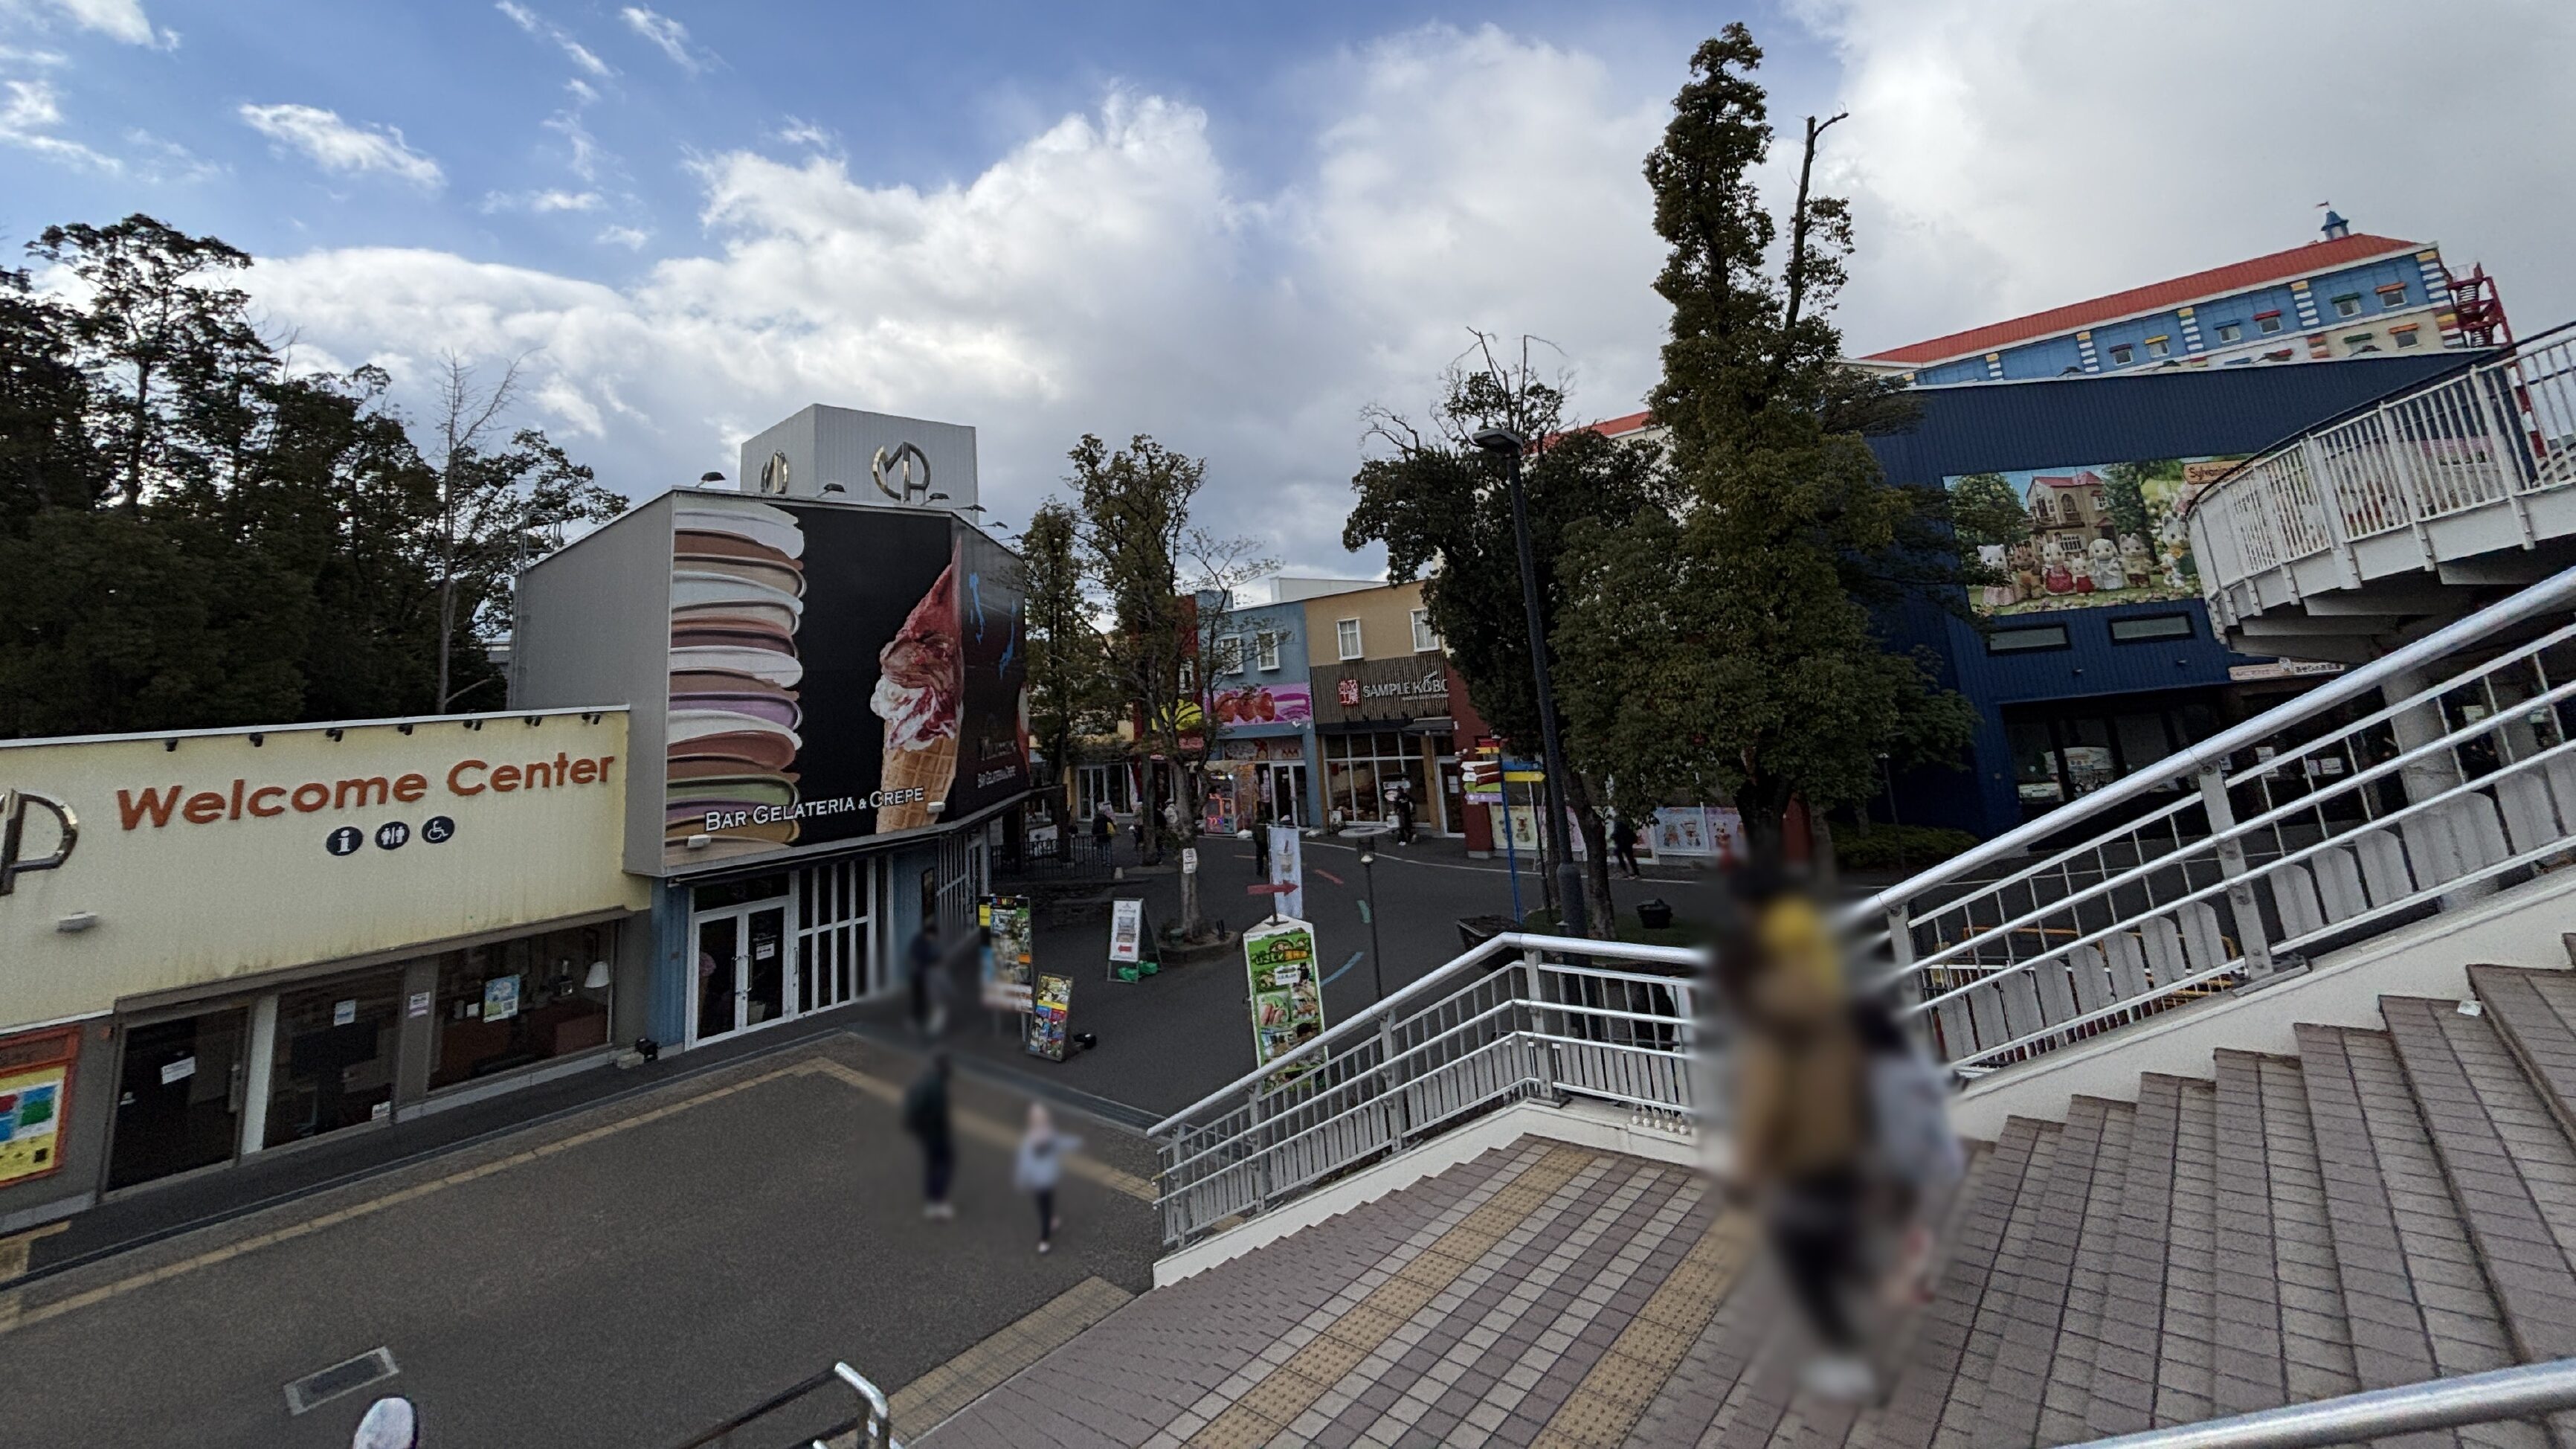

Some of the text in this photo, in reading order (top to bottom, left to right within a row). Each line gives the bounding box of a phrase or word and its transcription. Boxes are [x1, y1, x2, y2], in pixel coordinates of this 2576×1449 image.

[1362, 681, 1411, 698] SAMPLE
[117, 752, 616, 831] Welcome Center
[859, 798, 867, 810] &
